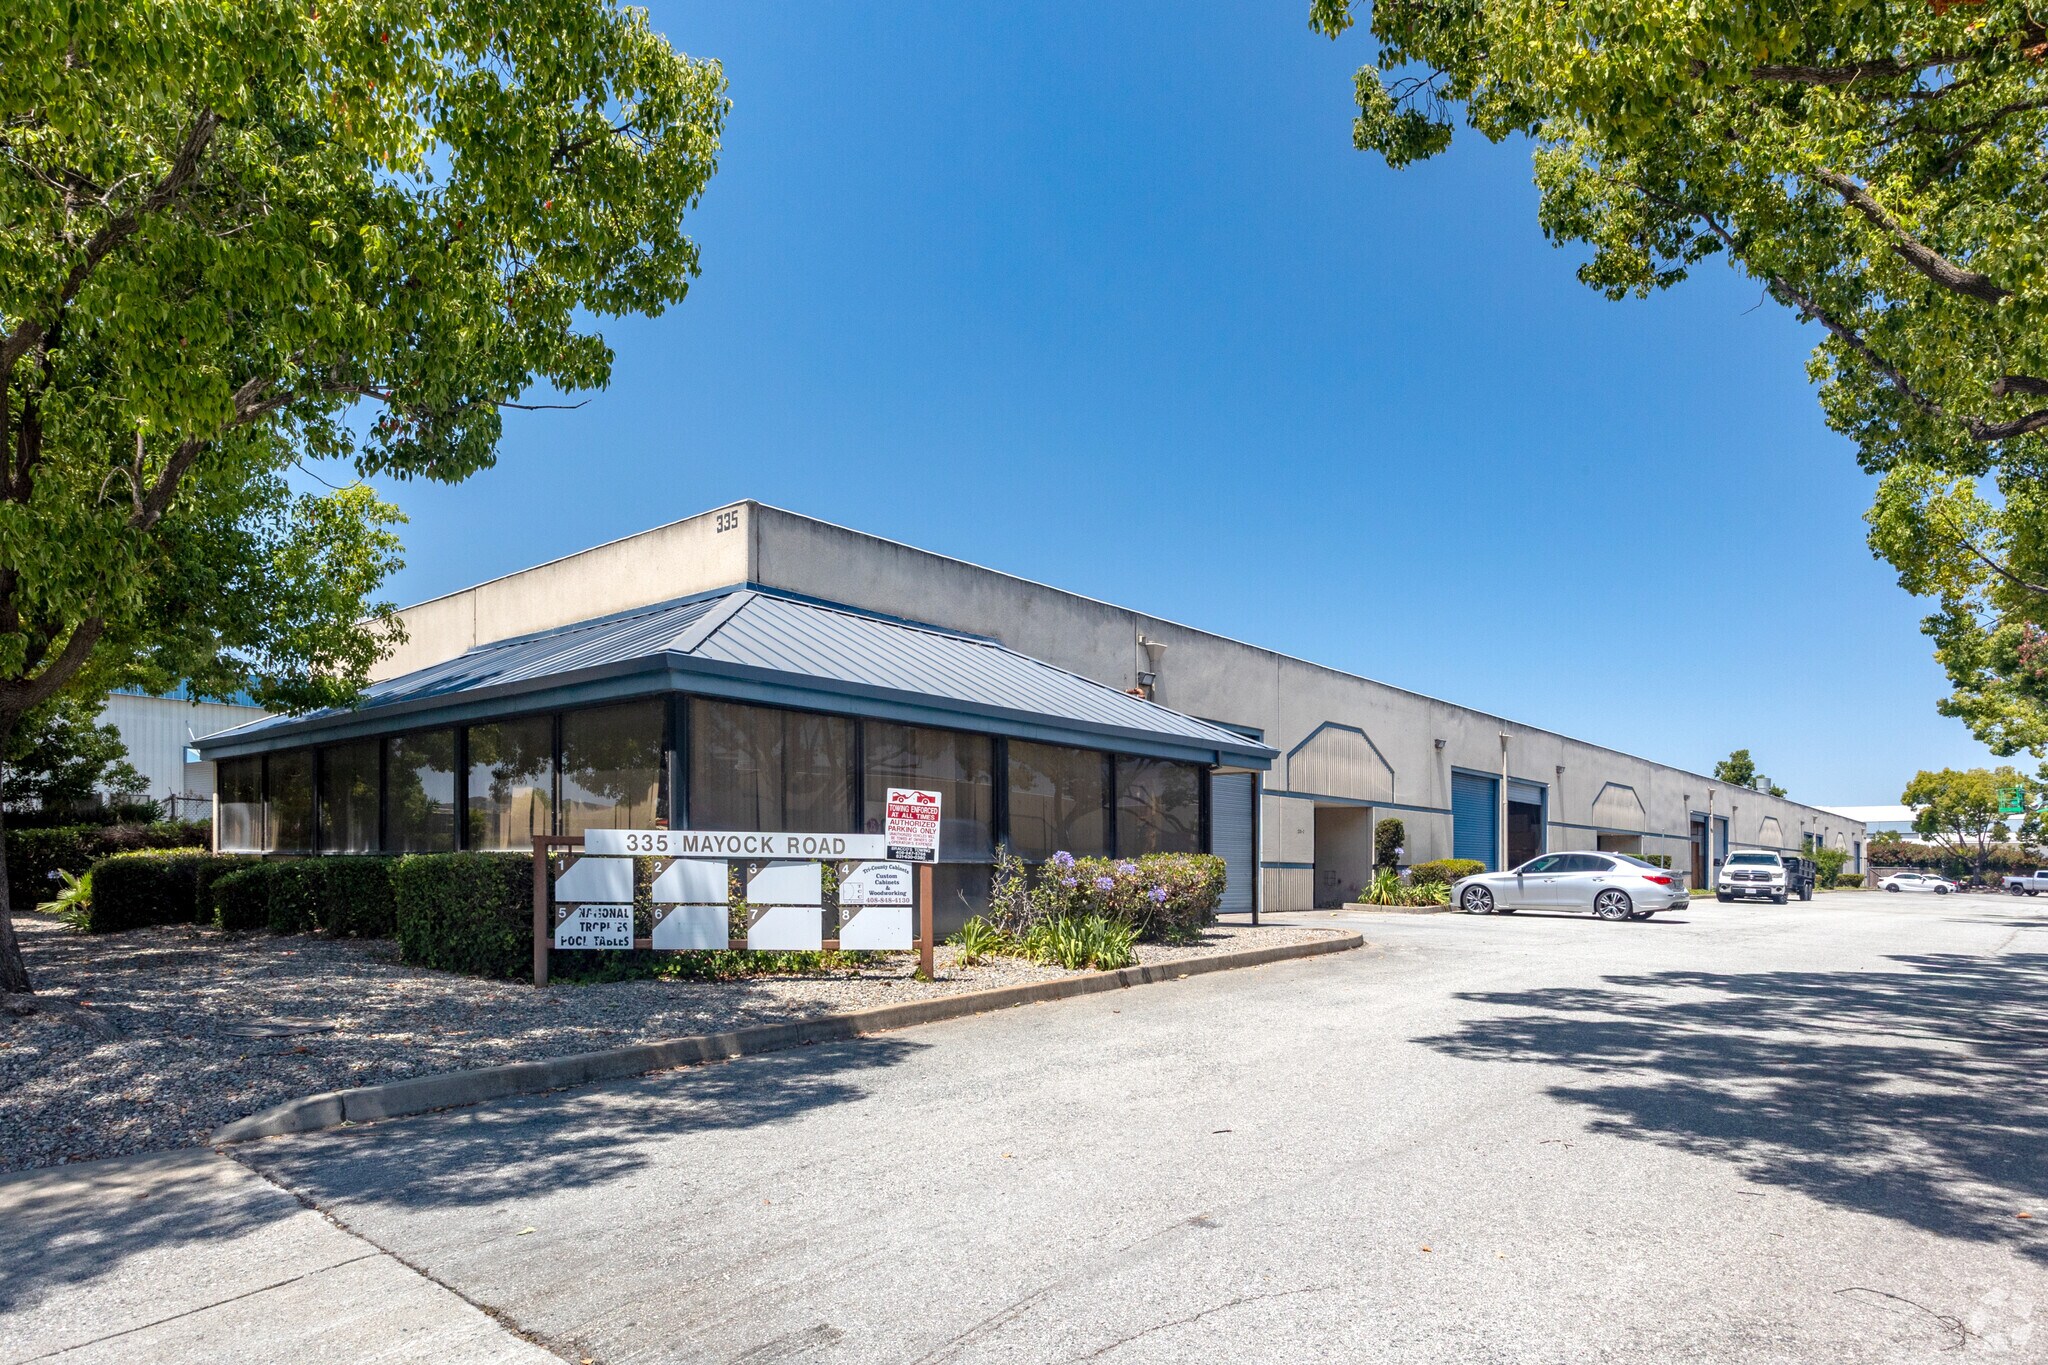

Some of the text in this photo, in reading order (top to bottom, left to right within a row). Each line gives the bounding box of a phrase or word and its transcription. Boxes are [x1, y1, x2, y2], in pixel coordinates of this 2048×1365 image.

[717, 510, 738, 533] 335
[889, 804, 938, 815] TOWING ENFORCED
[890, 819, 936, 828] AUTHORIZED
[888, 825, 917, 834] PARKING
[627, 834, 846, 855] 335 MAYOCK ROAD
[557, 860, 564, 871] 1
[654, 862, 662, 873] 2
[750, 863, 757, 874] 3
[841, 864, 849, 874] 4
[863, 864, 909, 874] Tri-County Cabinets
[558, 908, 567, 918] 5
[654, 909, 663, 920] 6
[750, 909, 758, 920] 7
[842, 909, 850, 920] 8
